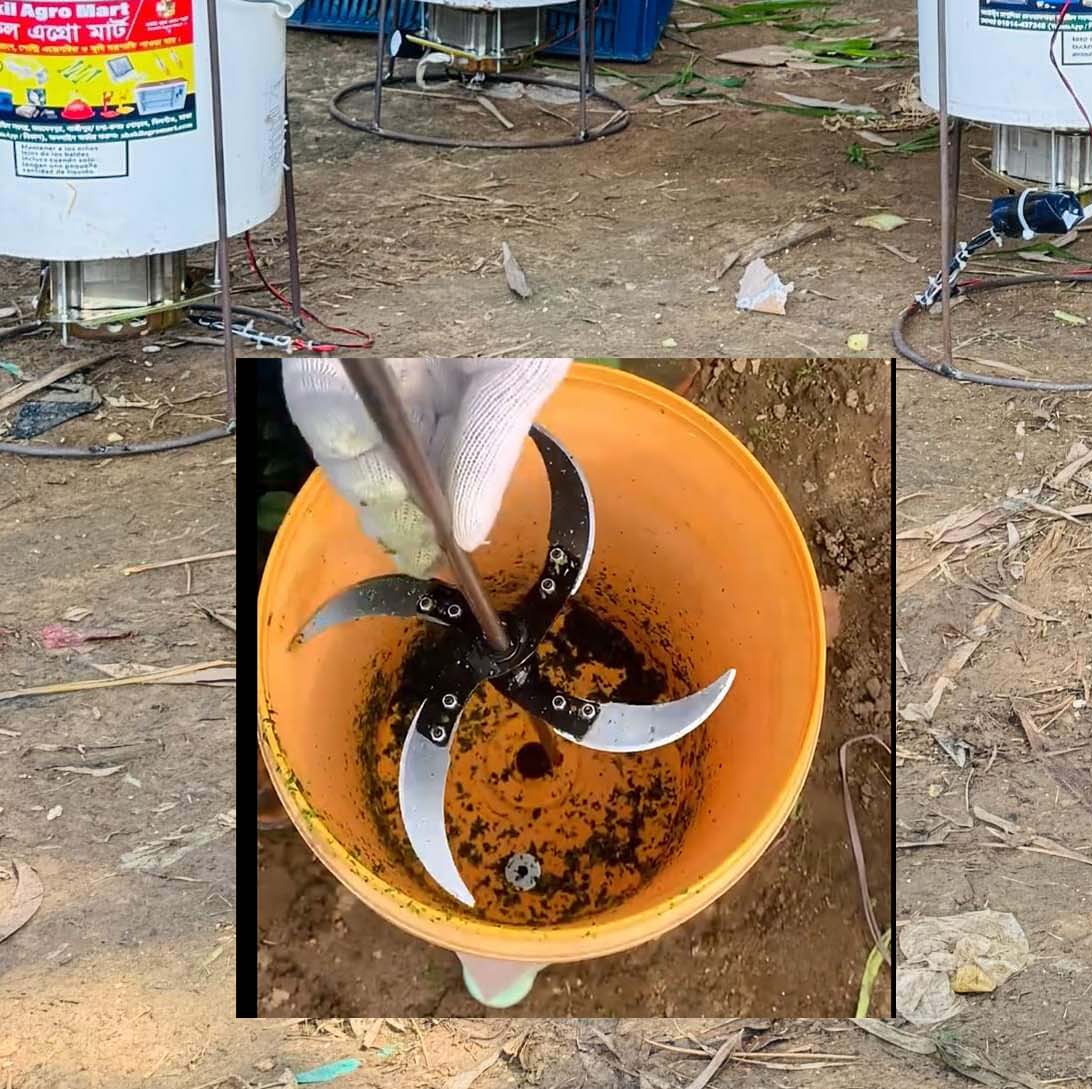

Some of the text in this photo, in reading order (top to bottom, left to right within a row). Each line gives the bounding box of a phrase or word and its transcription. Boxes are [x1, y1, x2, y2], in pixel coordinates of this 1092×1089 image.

[20, 3, 73, 22] Agro
[75, 2, 130, 18] Mart
[85, 14, 130, 41] মার্ট
